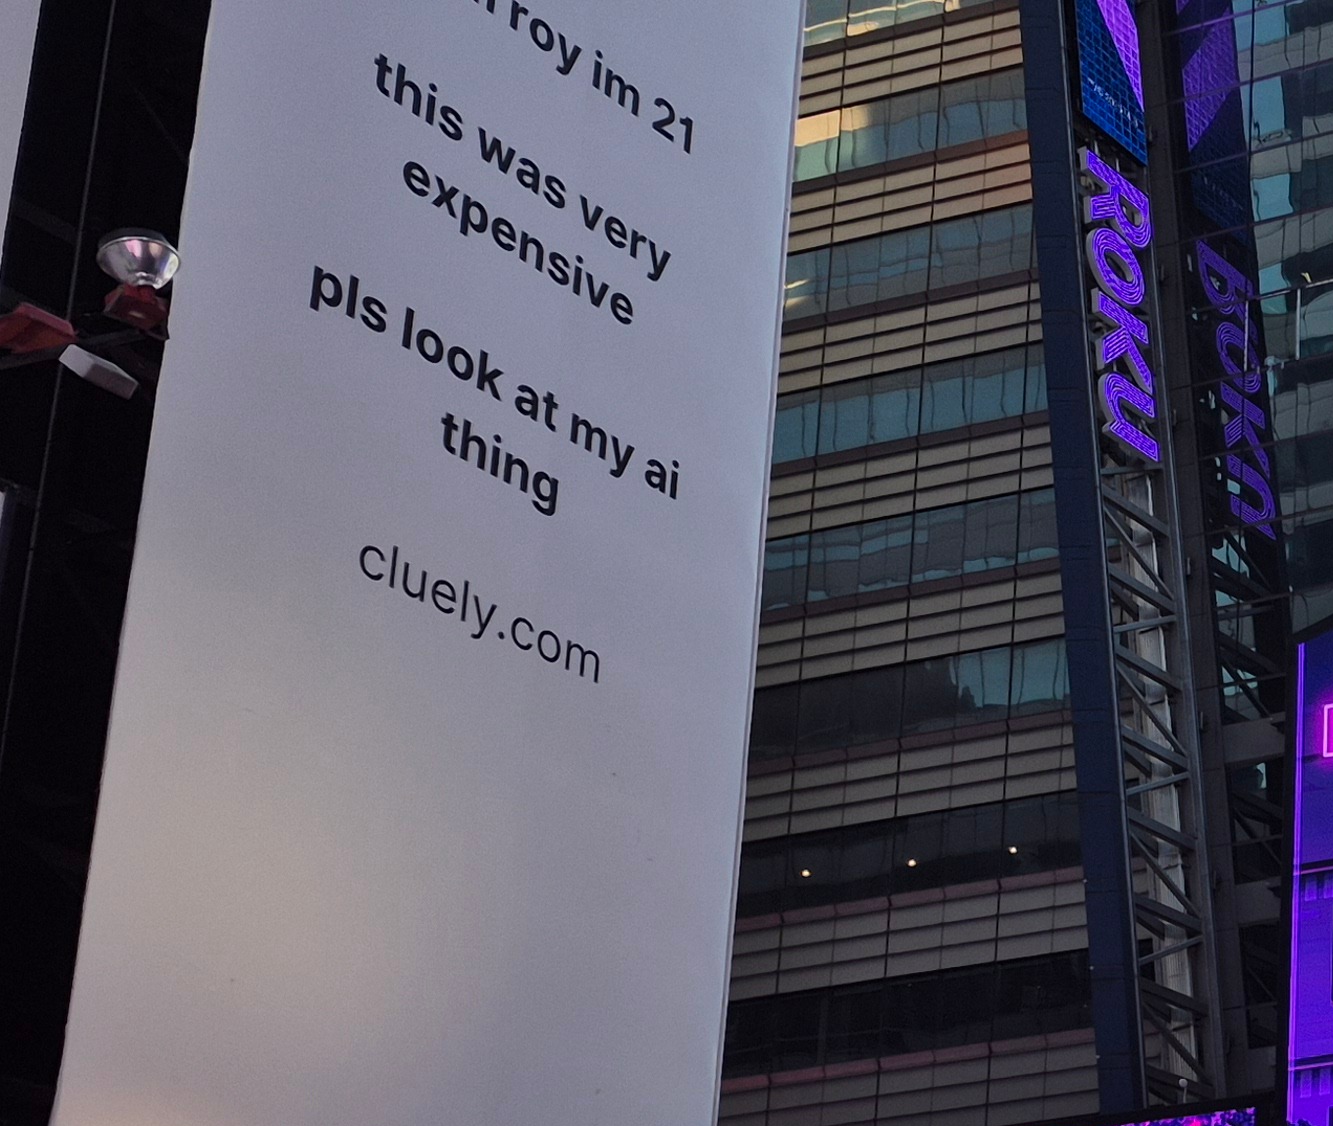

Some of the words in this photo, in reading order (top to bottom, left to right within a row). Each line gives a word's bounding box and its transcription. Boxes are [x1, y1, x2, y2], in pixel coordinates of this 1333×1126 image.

[509, 0, 582, 75] roy
[592, 50, 640, 117] im
[652, 97, 694, 154] 21
[374, 52, 463, 142] this
[478, 126, 566, 209] was
[580, 194, 672, 283] very
[403, 161, 634, 325] expensive
[309, 265, 387, 333] pls
[401, 307, 503, 401] look
[514, 384, 559, 432] at
[569, 413, 635, 478] my
[644, 458, 680, 500] ai
[1079, 147, 1161, 462] ROKU
[441, 412, 559, 516] thing
[358, 545, 601, 684] cluely.com
